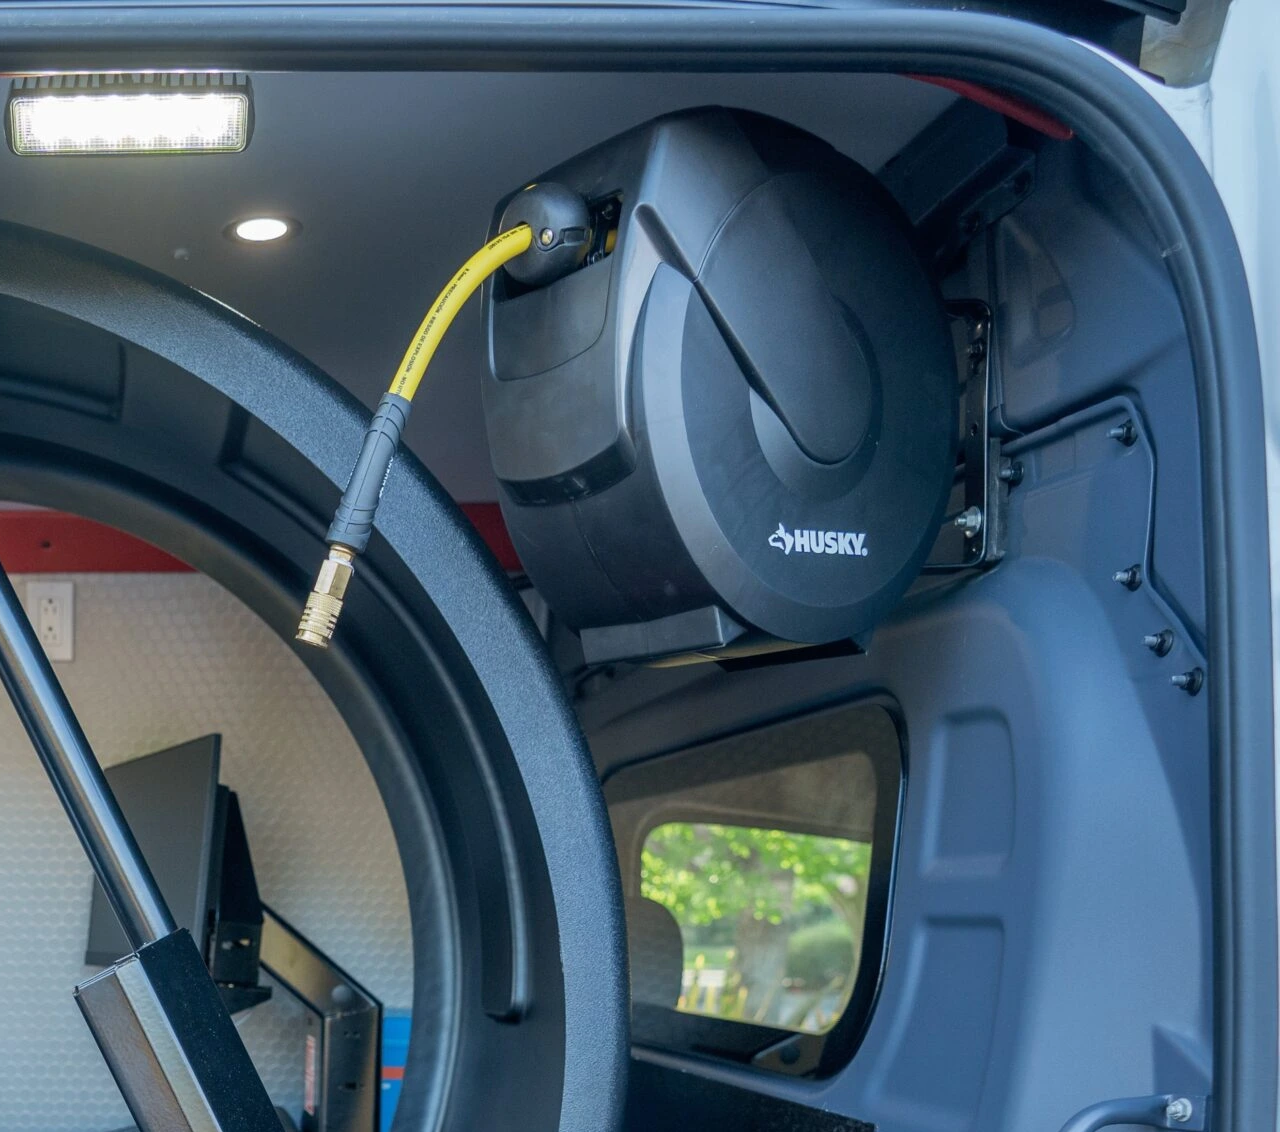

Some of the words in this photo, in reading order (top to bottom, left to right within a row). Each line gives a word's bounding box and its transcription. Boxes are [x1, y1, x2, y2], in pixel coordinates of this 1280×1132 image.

[436, 283, 457, 313] PRECAUCIÓN
[423, 316, 436, 335] RIESGO
[420, 334, 426, 343] DE
[406, 342, 422, 373] EXPLOSIÓN
[400, 376, 407, 385] NO
